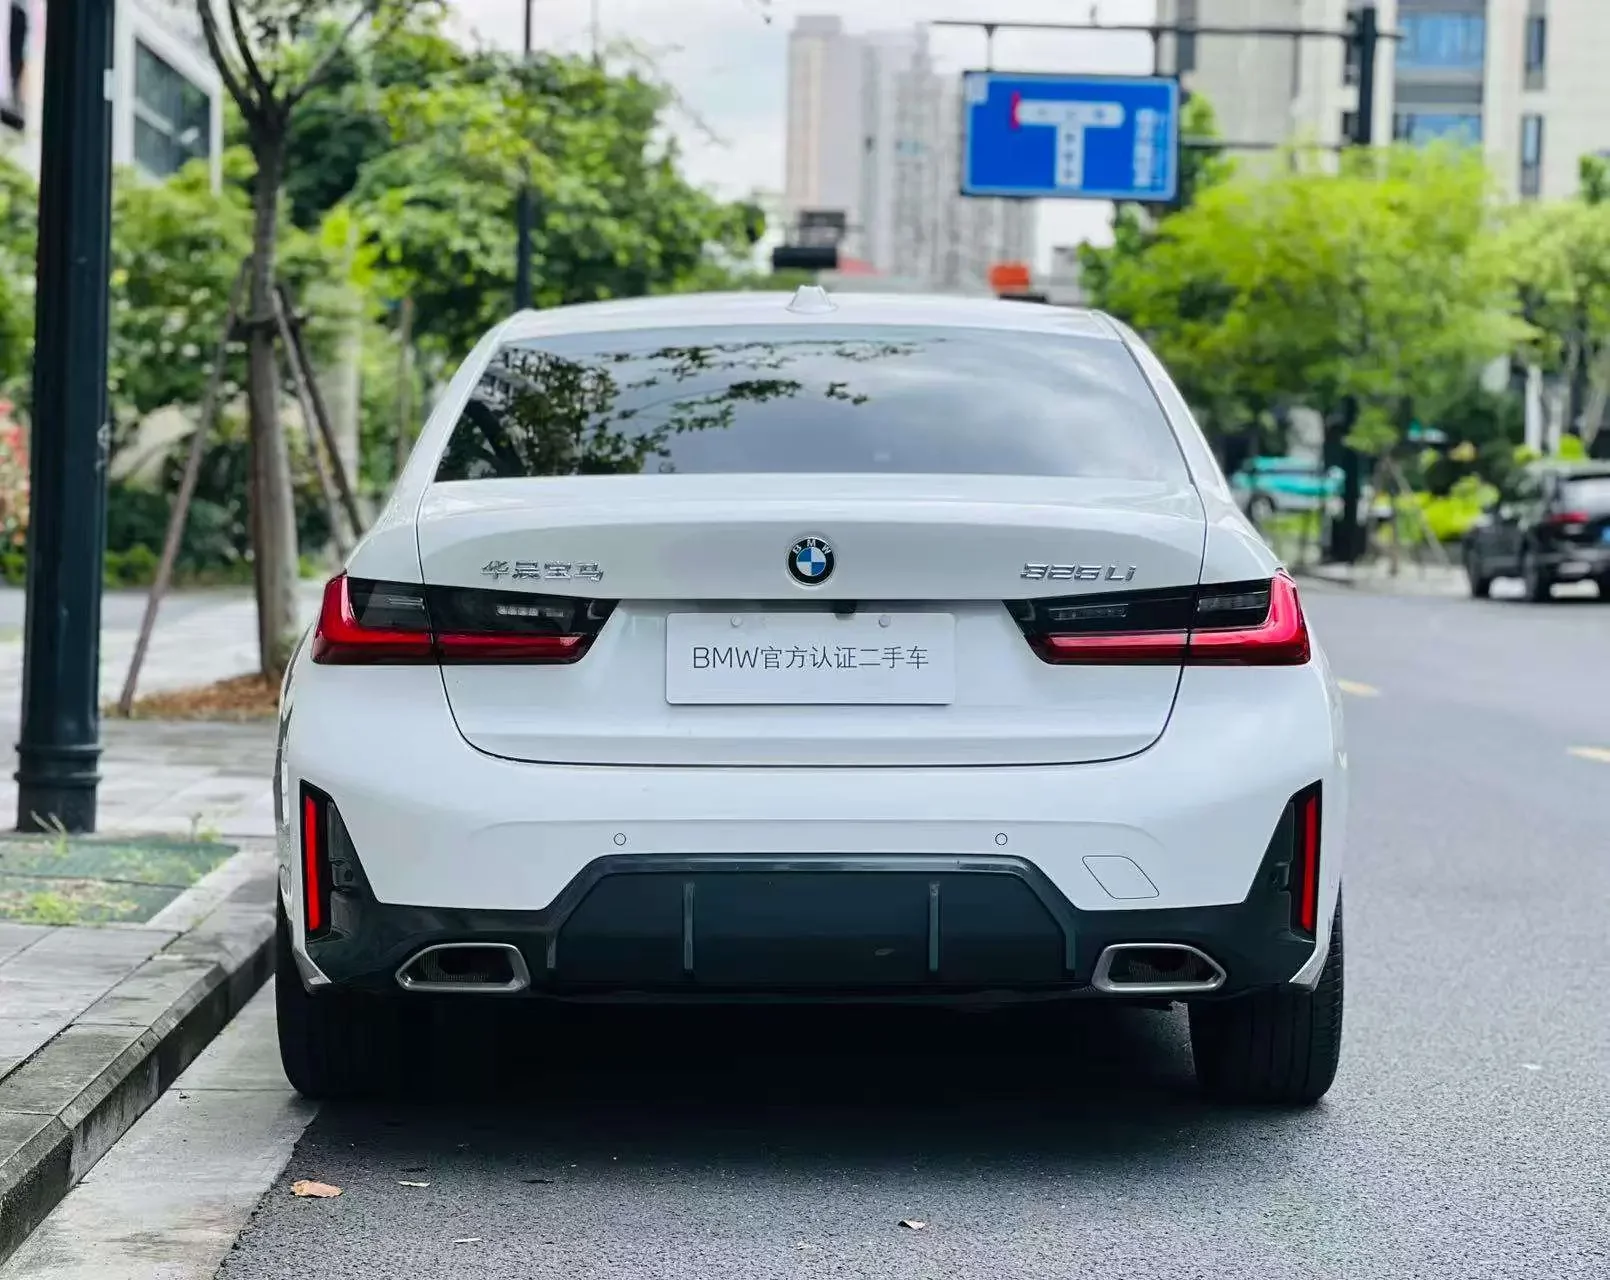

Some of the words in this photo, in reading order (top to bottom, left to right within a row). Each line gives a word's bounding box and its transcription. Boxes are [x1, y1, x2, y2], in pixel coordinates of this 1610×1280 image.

[792, 539, 832, 555] BMW
[692, 645, 930, 671] BMW官方认证二手车
